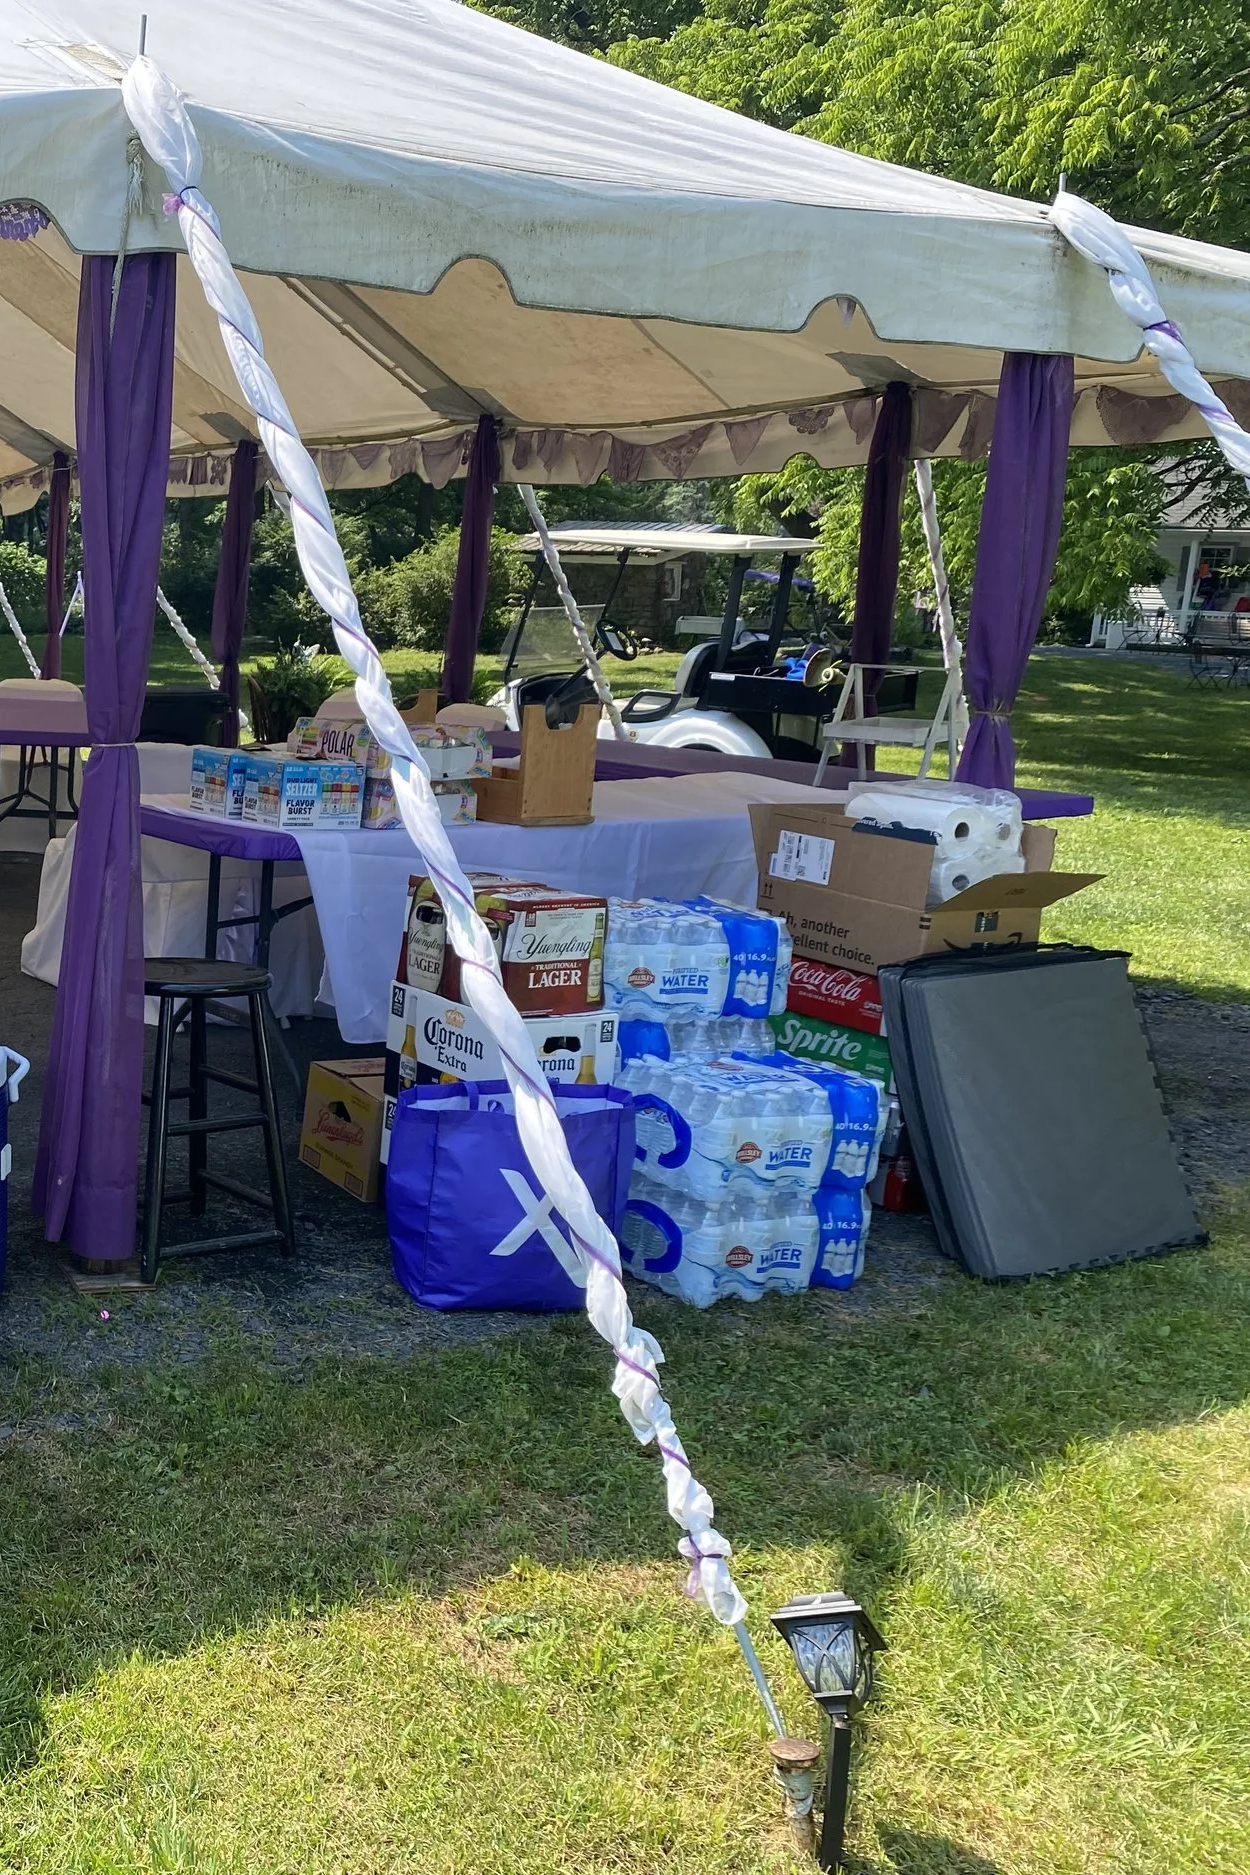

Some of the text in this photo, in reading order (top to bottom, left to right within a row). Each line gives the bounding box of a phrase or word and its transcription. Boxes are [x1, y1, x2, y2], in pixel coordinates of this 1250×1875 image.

[322, 730, 355, 757] POLAR
[286, 783, 318, 797] SELTZER
[286, 799, 315, 808] FLAVOR
[287, 806, 313, 815] BURST
[778, 910, 851, 939] Ah, another
[517, 933, 593, 960] Yuengling
[831, 943, 875, 966] choice.
[408, 953, 440, 975] LAGER
[747, 953, 767, 961] 16.9
[534, 961, 579, 971] TRADITIONAL
[528, 969, 582, 989] LAGER
[662, 974, 710, 987] WATER
[789, 961, 870, 1001] Coca-Cola
[394, 988, 403, 1004] 24
[602, 1022, 612, 1033] 24
[424, 1016, 484, 1061] Corona
[777, 1019, 862, 1061] Sprite
[435, 1045, 468, 1073] Extra
[849, 1122, 869, 1131] 16.9
[769, 1147, 813, 1163] WATER
[836, 1221, 857, 1230] 16.9
[760, 1249, 802, 1266] WATER
